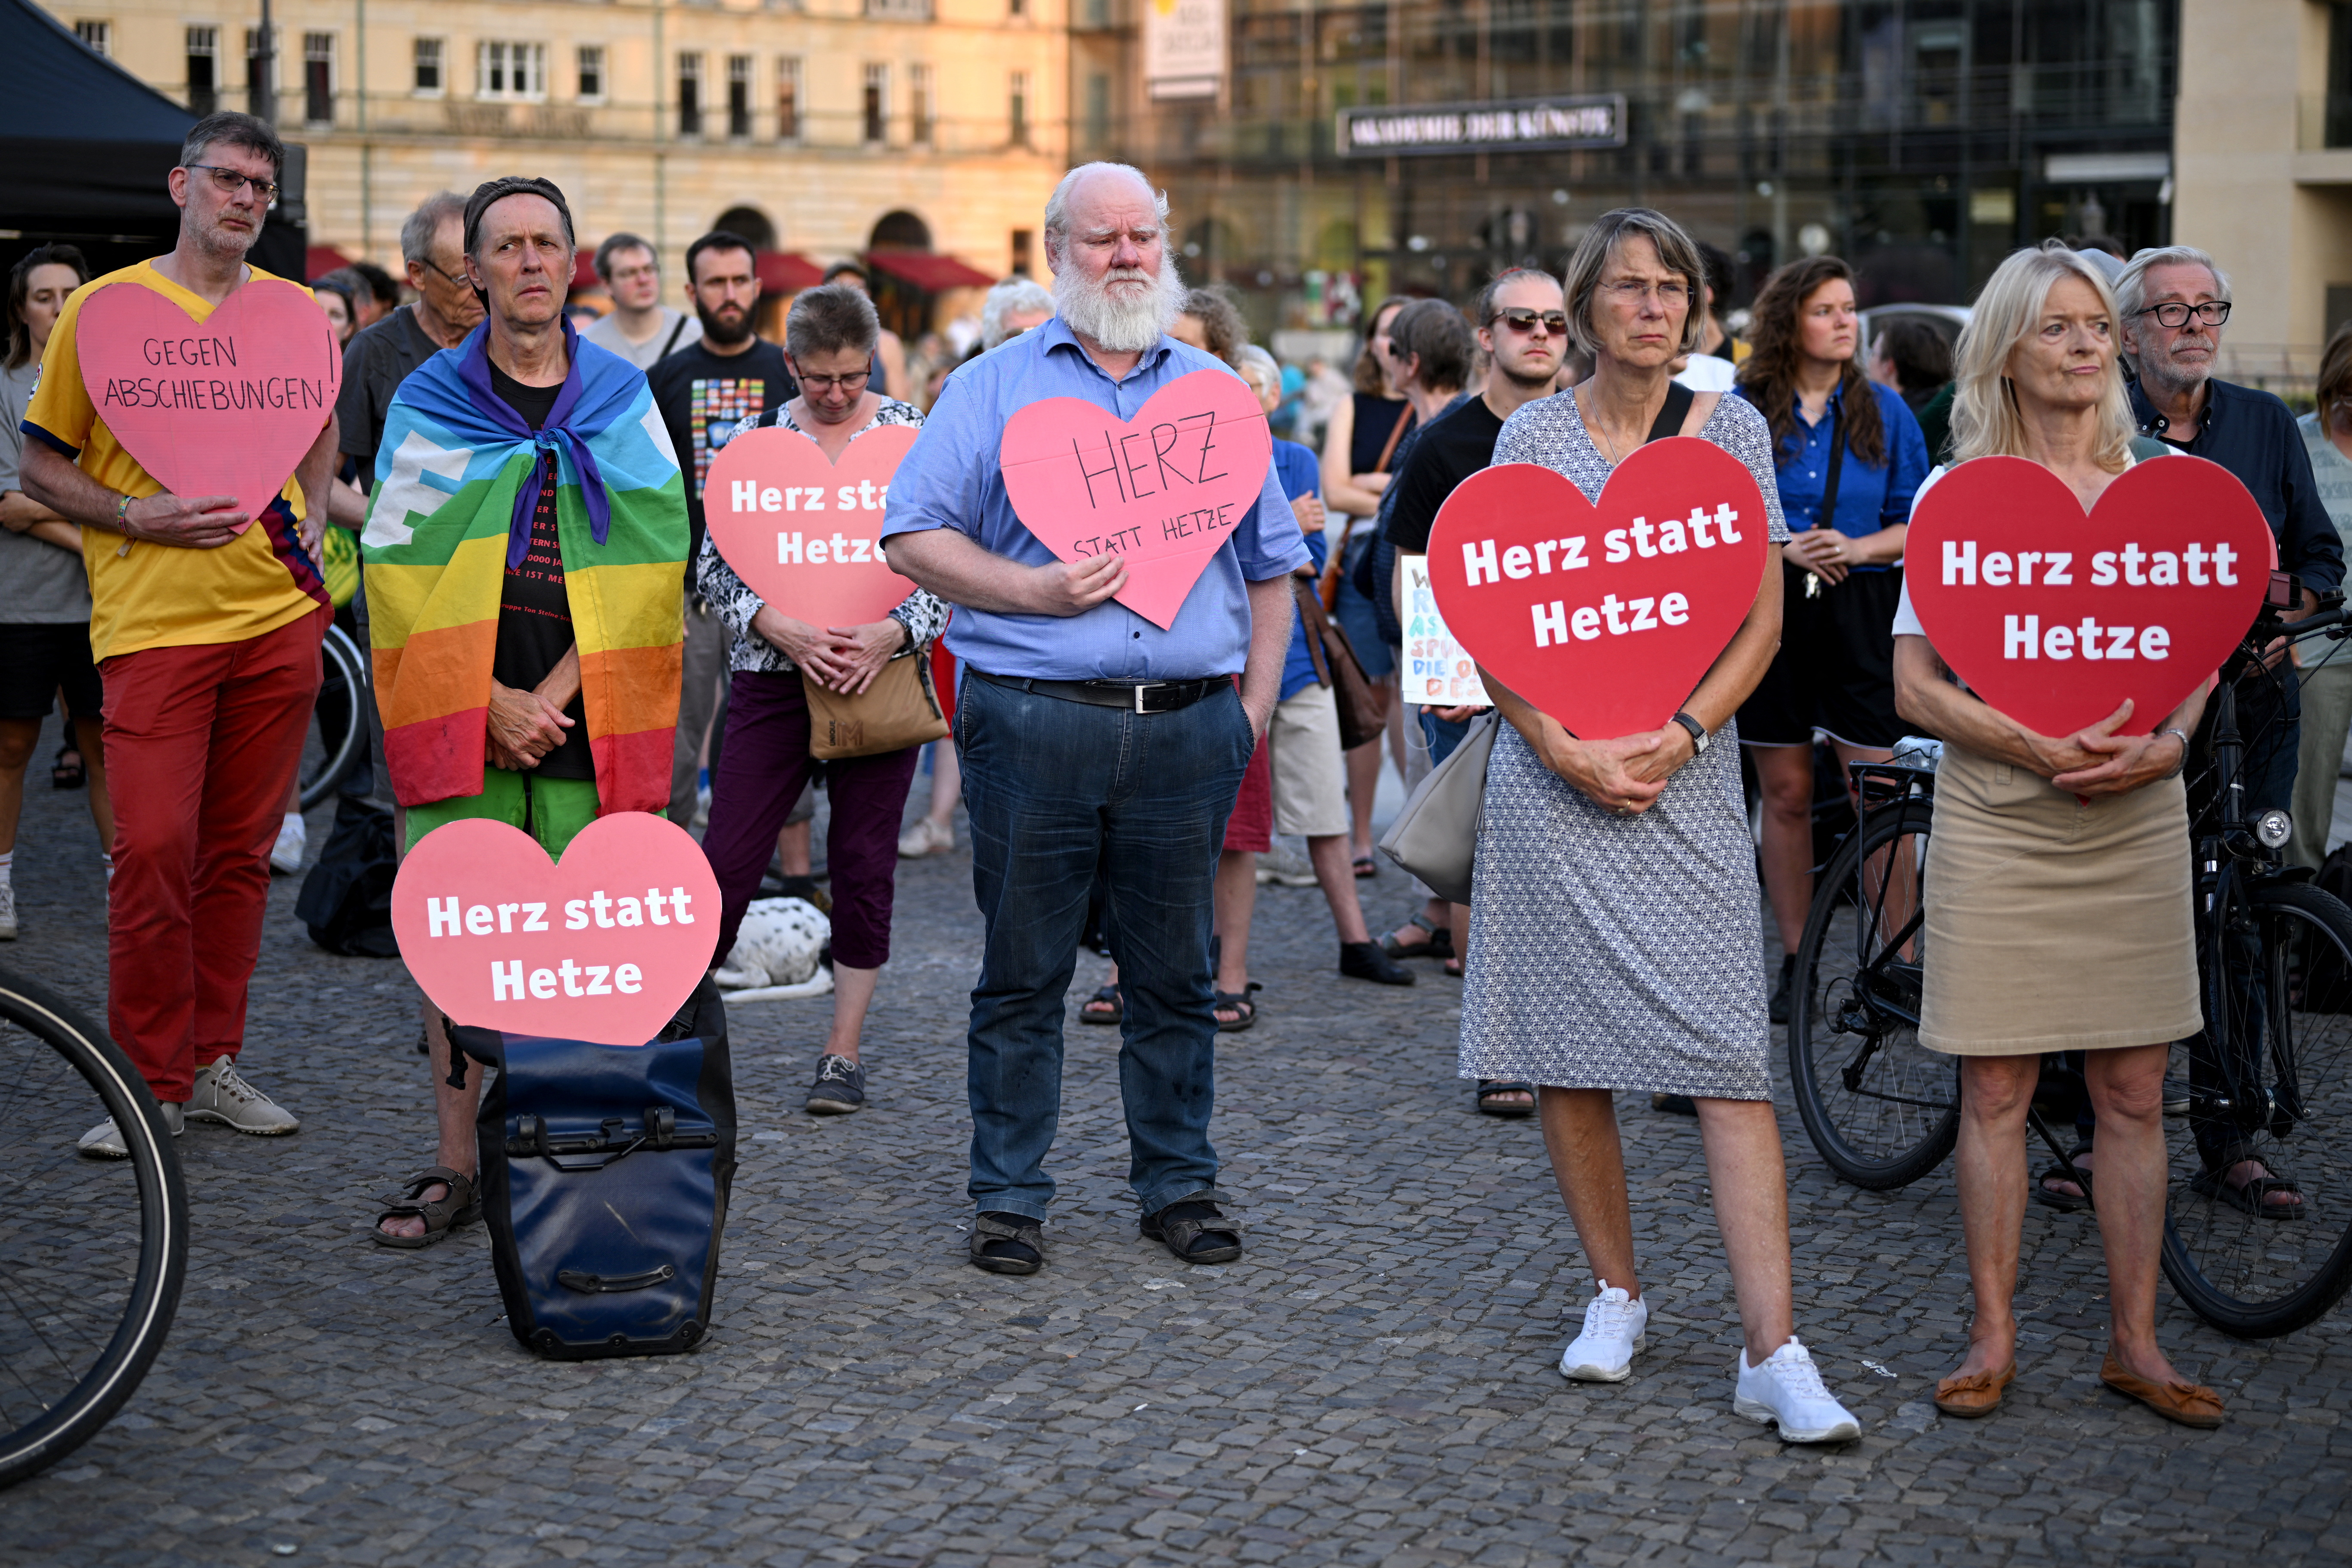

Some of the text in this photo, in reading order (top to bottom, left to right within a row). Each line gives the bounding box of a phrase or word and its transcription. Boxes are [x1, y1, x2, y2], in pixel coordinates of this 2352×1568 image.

[143, 336, 236, 366] GEGEN
[1072, 411, 1229, 509] HERZ
[732, 480, 825, 512] Herz
[778, 532, 887, 564] Hetze
[1074, 503, 1235, 562] STATT HETZE
[1462, 502, 1742, 587] Herz statt
[526, 570, 543, 579] IST
[548, 574, 565, 584] ME
[1942, 541, 2238, 586] Herz statt
[538, 609, 559, 618] Steine
[1413, 589, 1440, 614] R
[1409, 615, 1451, 637] AS
[1531, 592, 1689, 647] Hetze
[2004, 615, 2170, 660] Hetze
[1413, 660, 1446, 676] DIE
[1426, 677, 1481, 698] DES
[427, 887, 695, 937] Herz statt
[491, 959, 642, 1001] Hetze
